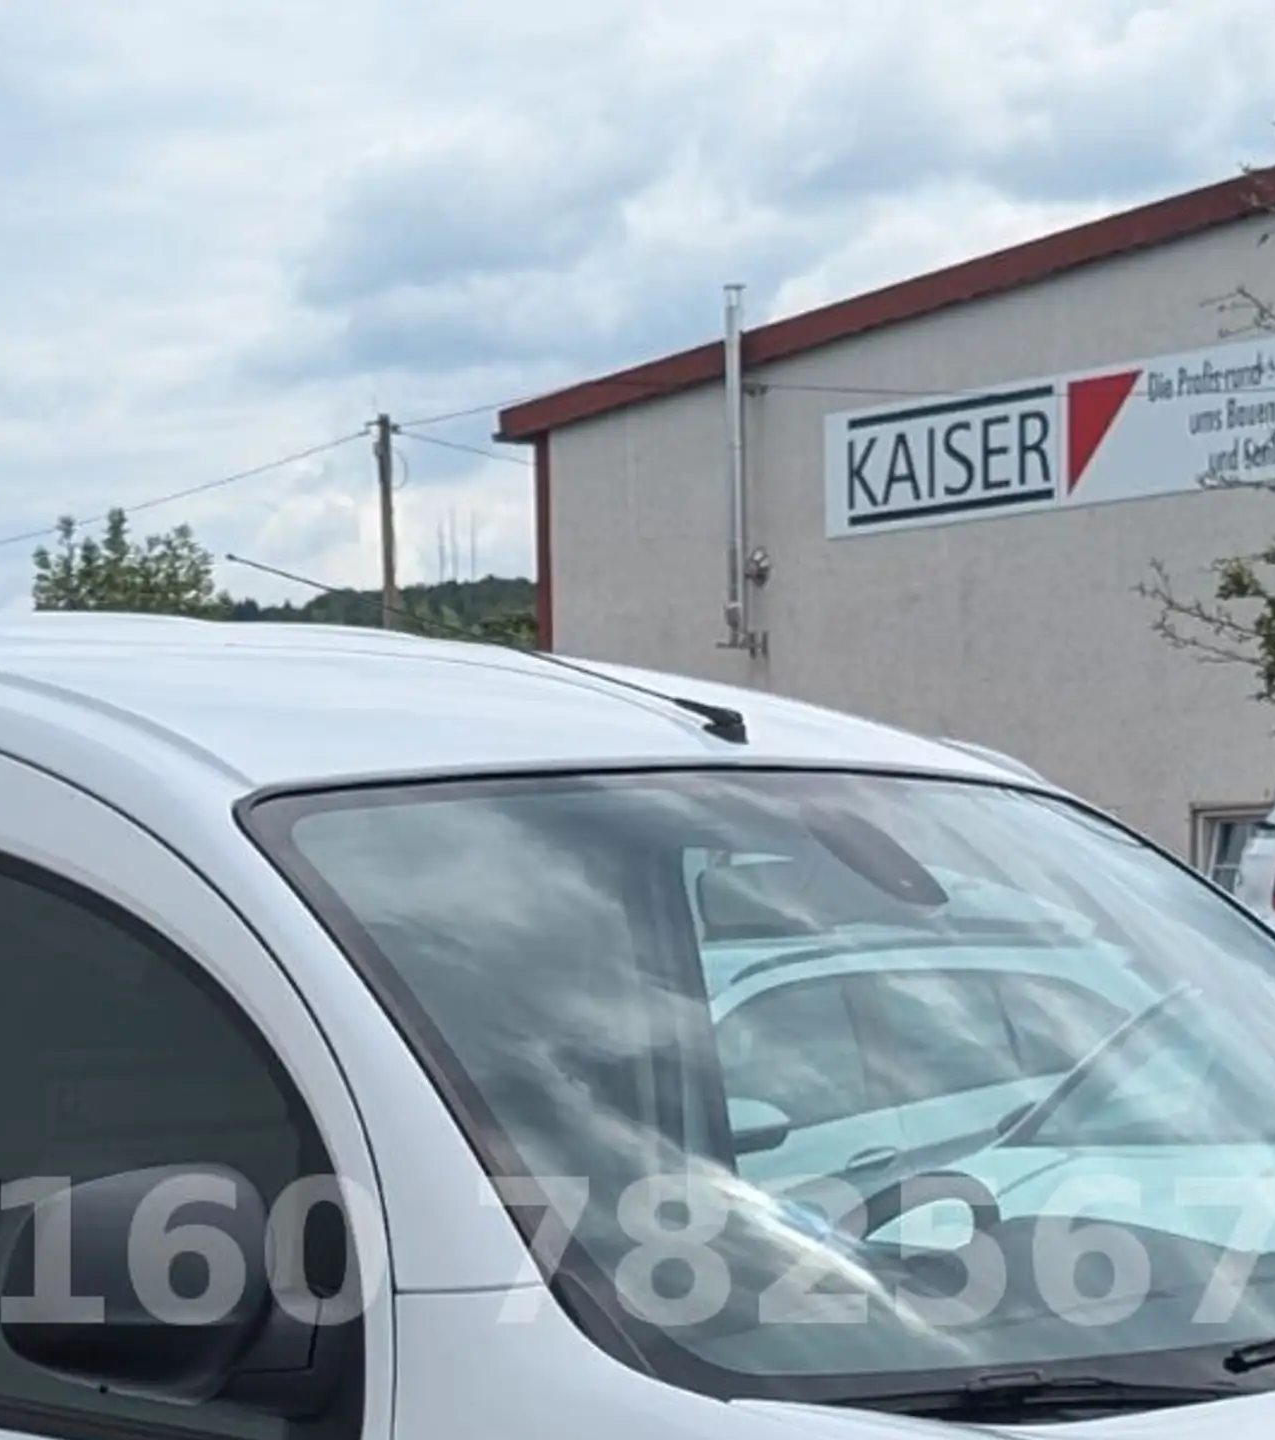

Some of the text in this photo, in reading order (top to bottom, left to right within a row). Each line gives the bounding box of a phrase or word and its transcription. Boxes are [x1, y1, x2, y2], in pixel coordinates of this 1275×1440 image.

[1148, 352, 1264, 402] Die Profis rund
[1189, 398, 1275, 435] ums Bauen
[847, 411, 1051, 510] KAISER
[1208, 438, 1239, 472] und
